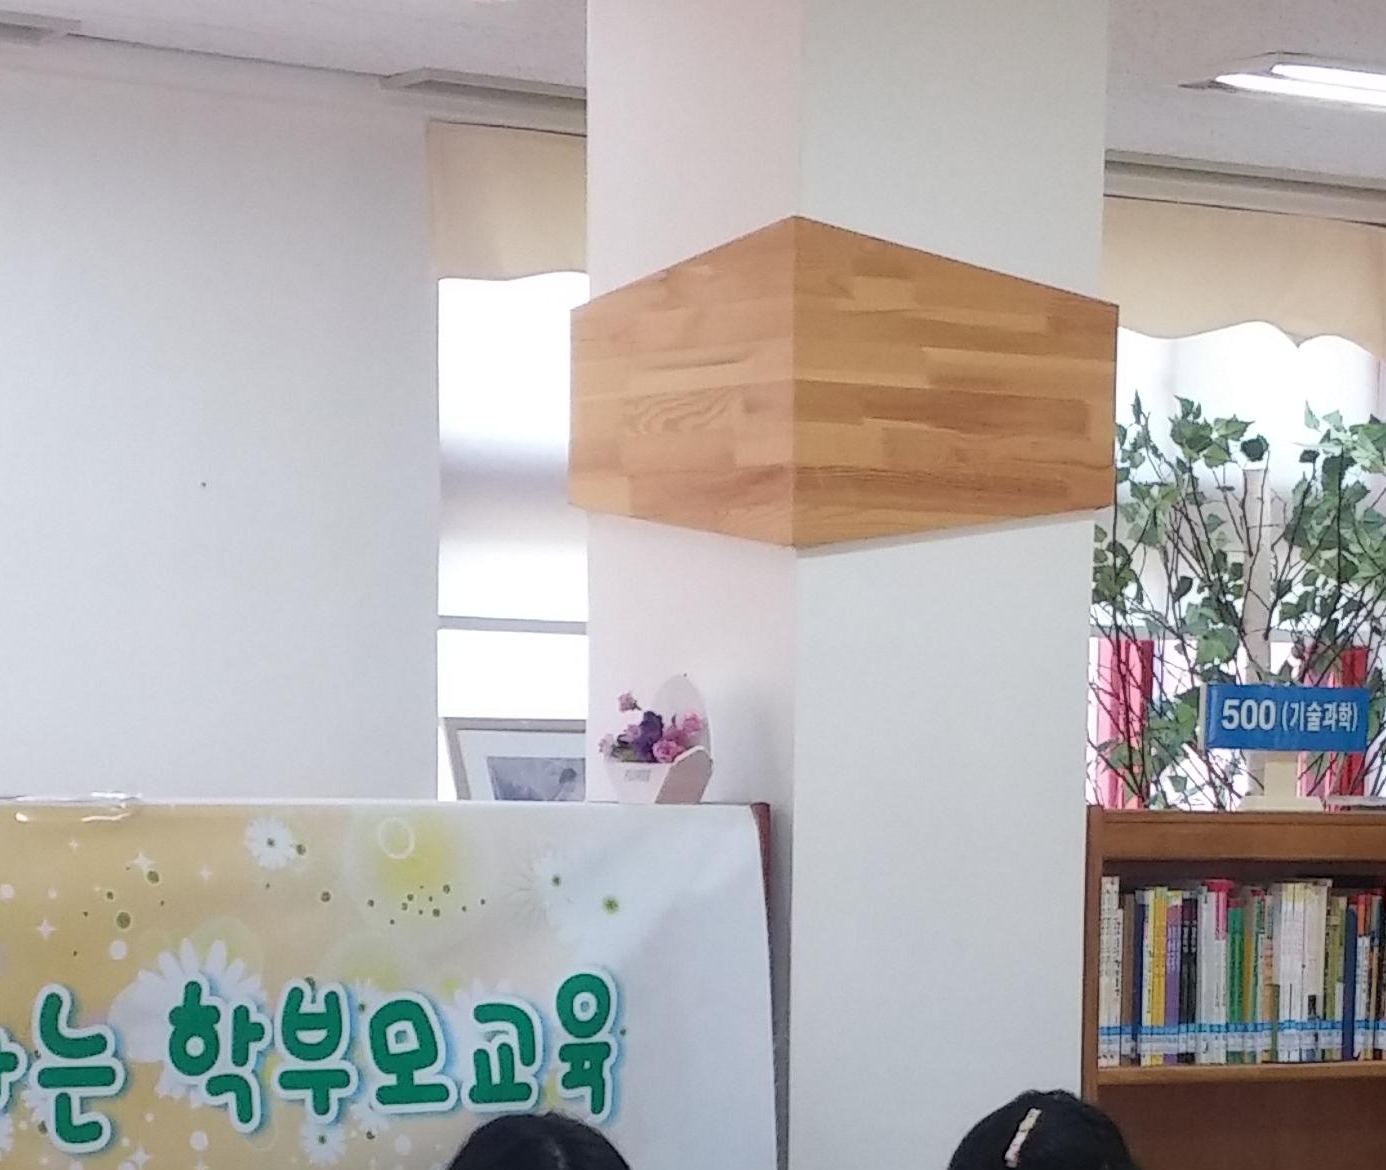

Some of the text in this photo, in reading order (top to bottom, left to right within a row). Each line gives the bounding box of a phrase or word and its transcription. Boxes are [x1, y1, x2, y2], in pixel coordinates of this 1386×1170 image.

[1221, 699, 1359, 732] 500 (기술과학)
[167, 972, 613, 1124] 학부모교육
